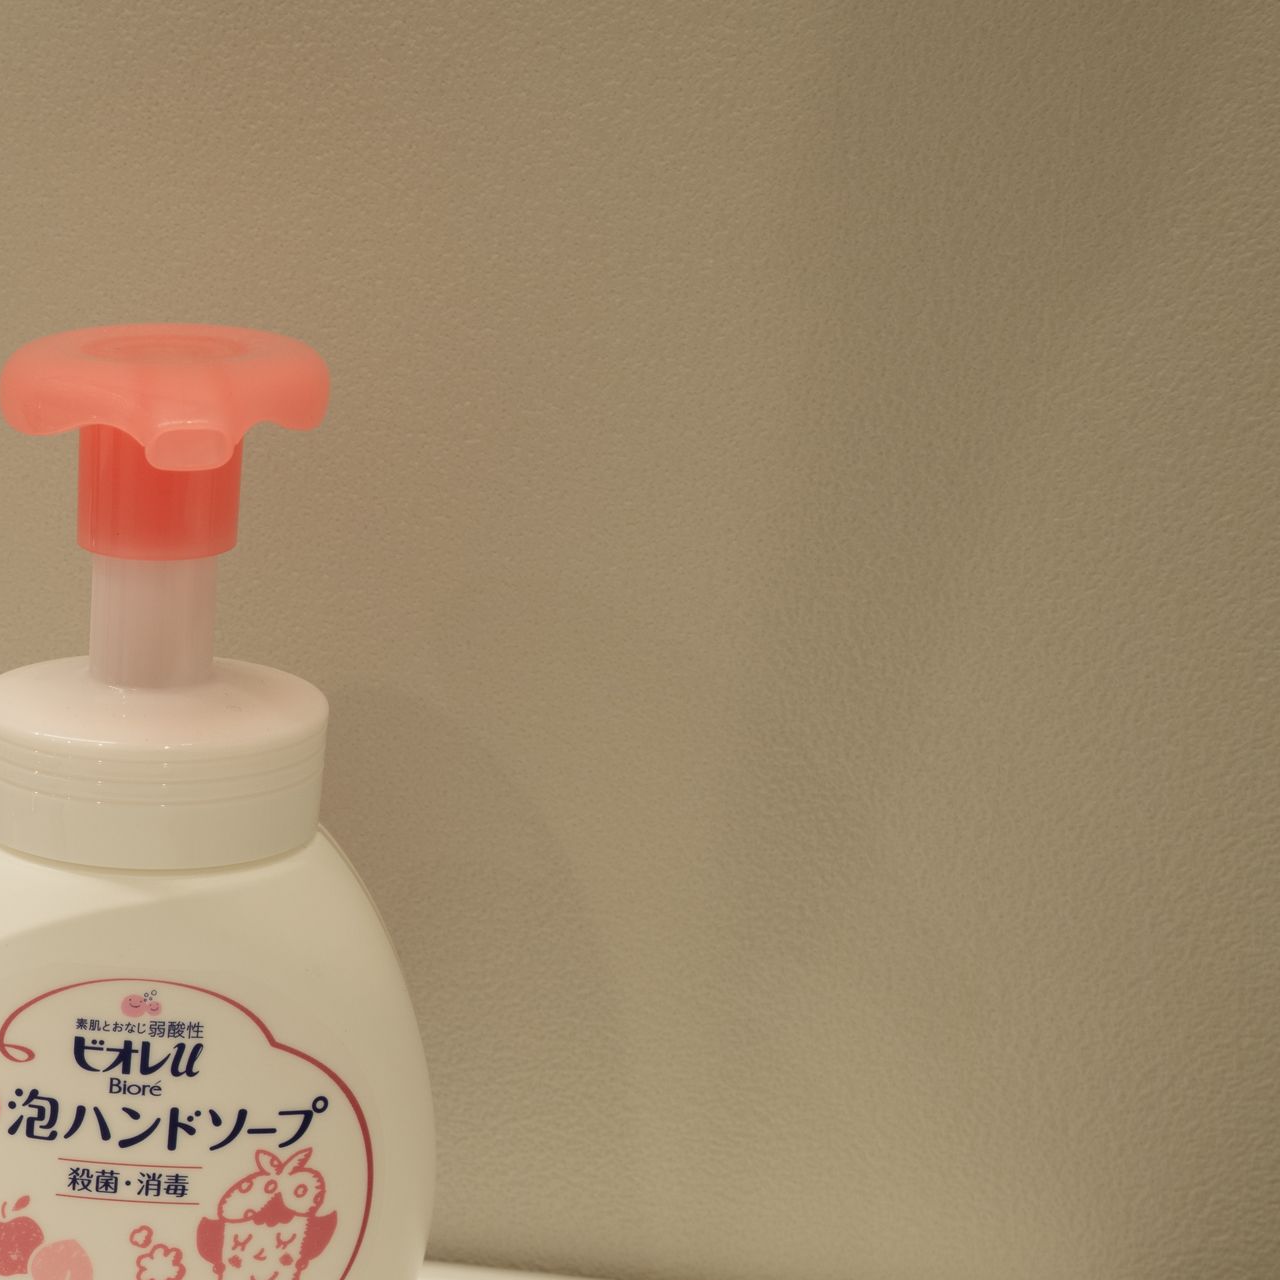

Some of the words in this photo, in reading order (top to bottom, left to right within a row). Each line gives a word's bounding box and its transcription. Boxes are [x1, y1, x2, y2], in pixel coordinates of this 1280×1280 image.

[108, 1077, 162, 1096] Bioré
[8, 1087, 329, 1152] 泡ハンドソープ
[67, 1166, 190, 1198] 殺菌・消毒
